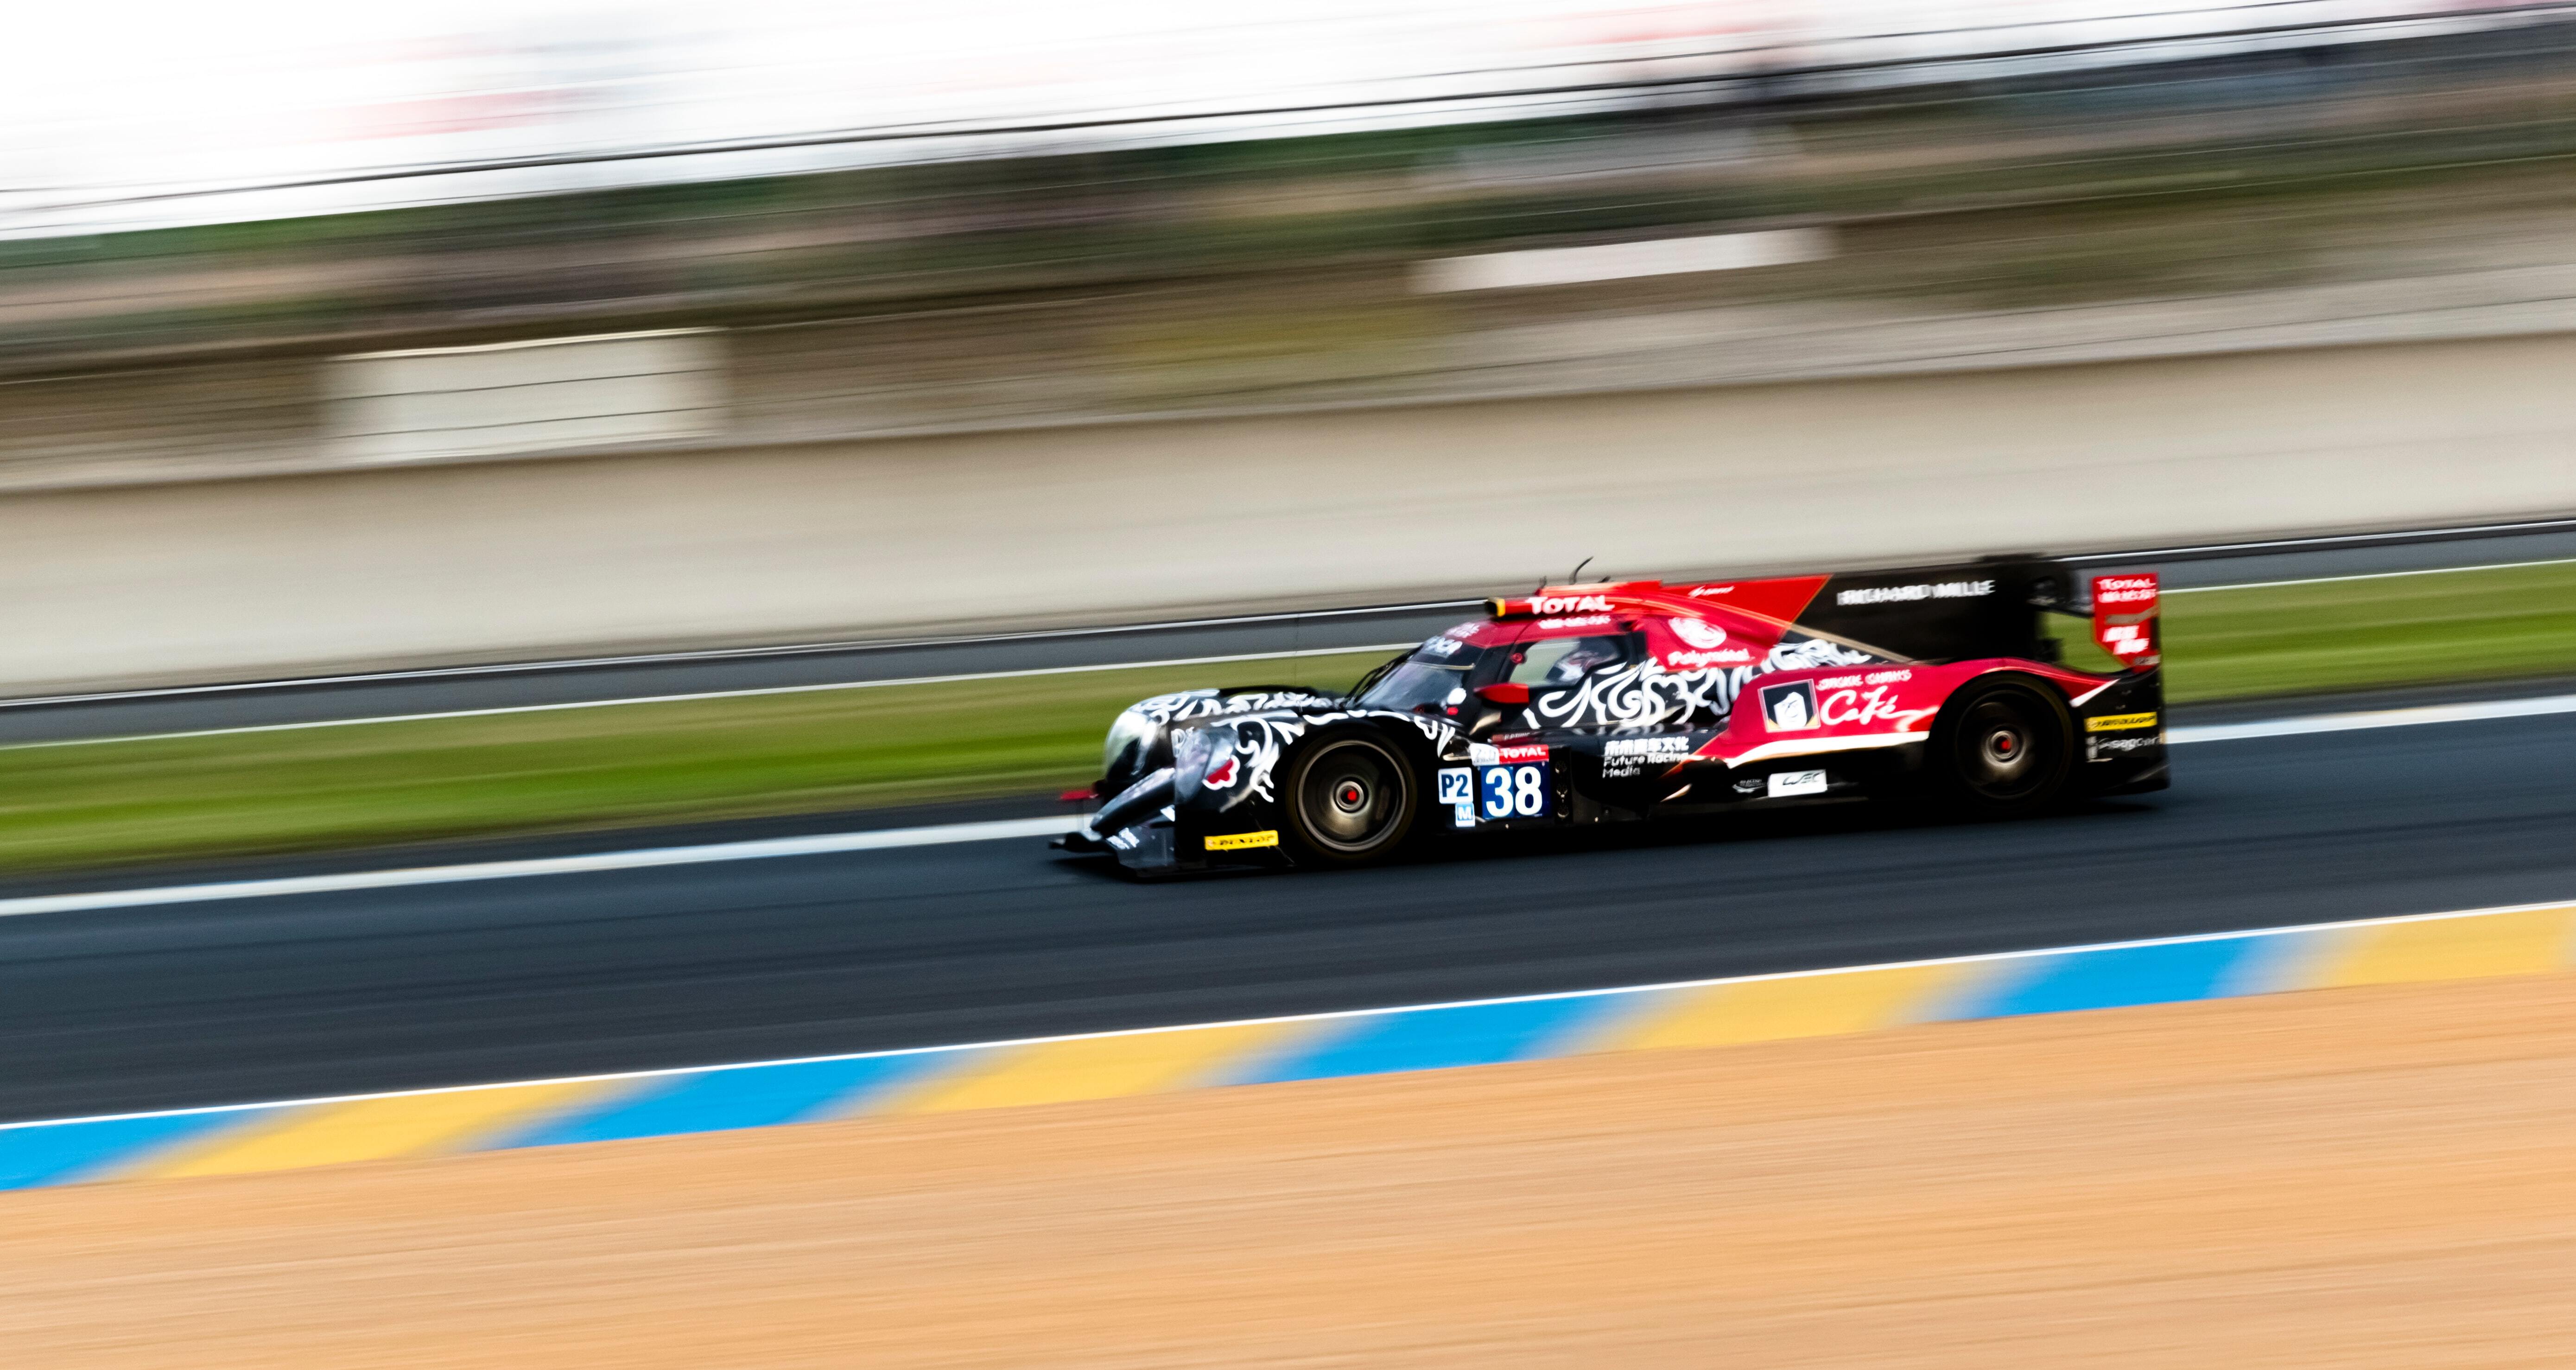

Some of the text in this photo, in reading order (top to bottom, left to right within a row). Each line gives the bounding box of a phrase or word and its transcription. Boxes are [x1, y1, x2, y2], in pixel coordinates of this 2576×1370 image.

[1837, 580, 1995, 605] RICHARD MILLE
[2097, 578, 2156, 591] TOTAL
[1526, 595, 1615, 615] TOTAL
[1820, 686, 1936, 725] Café
[1500, 747, 1546, 758] TOTAL
[1603, 753, 1645, 767] Future
[1602, 766, 1641, 778] Media
[1441, 774, 1469, 797] P2
[1485, 766, 1542, 817] 38
[1458, 806, 1473, 820] M
